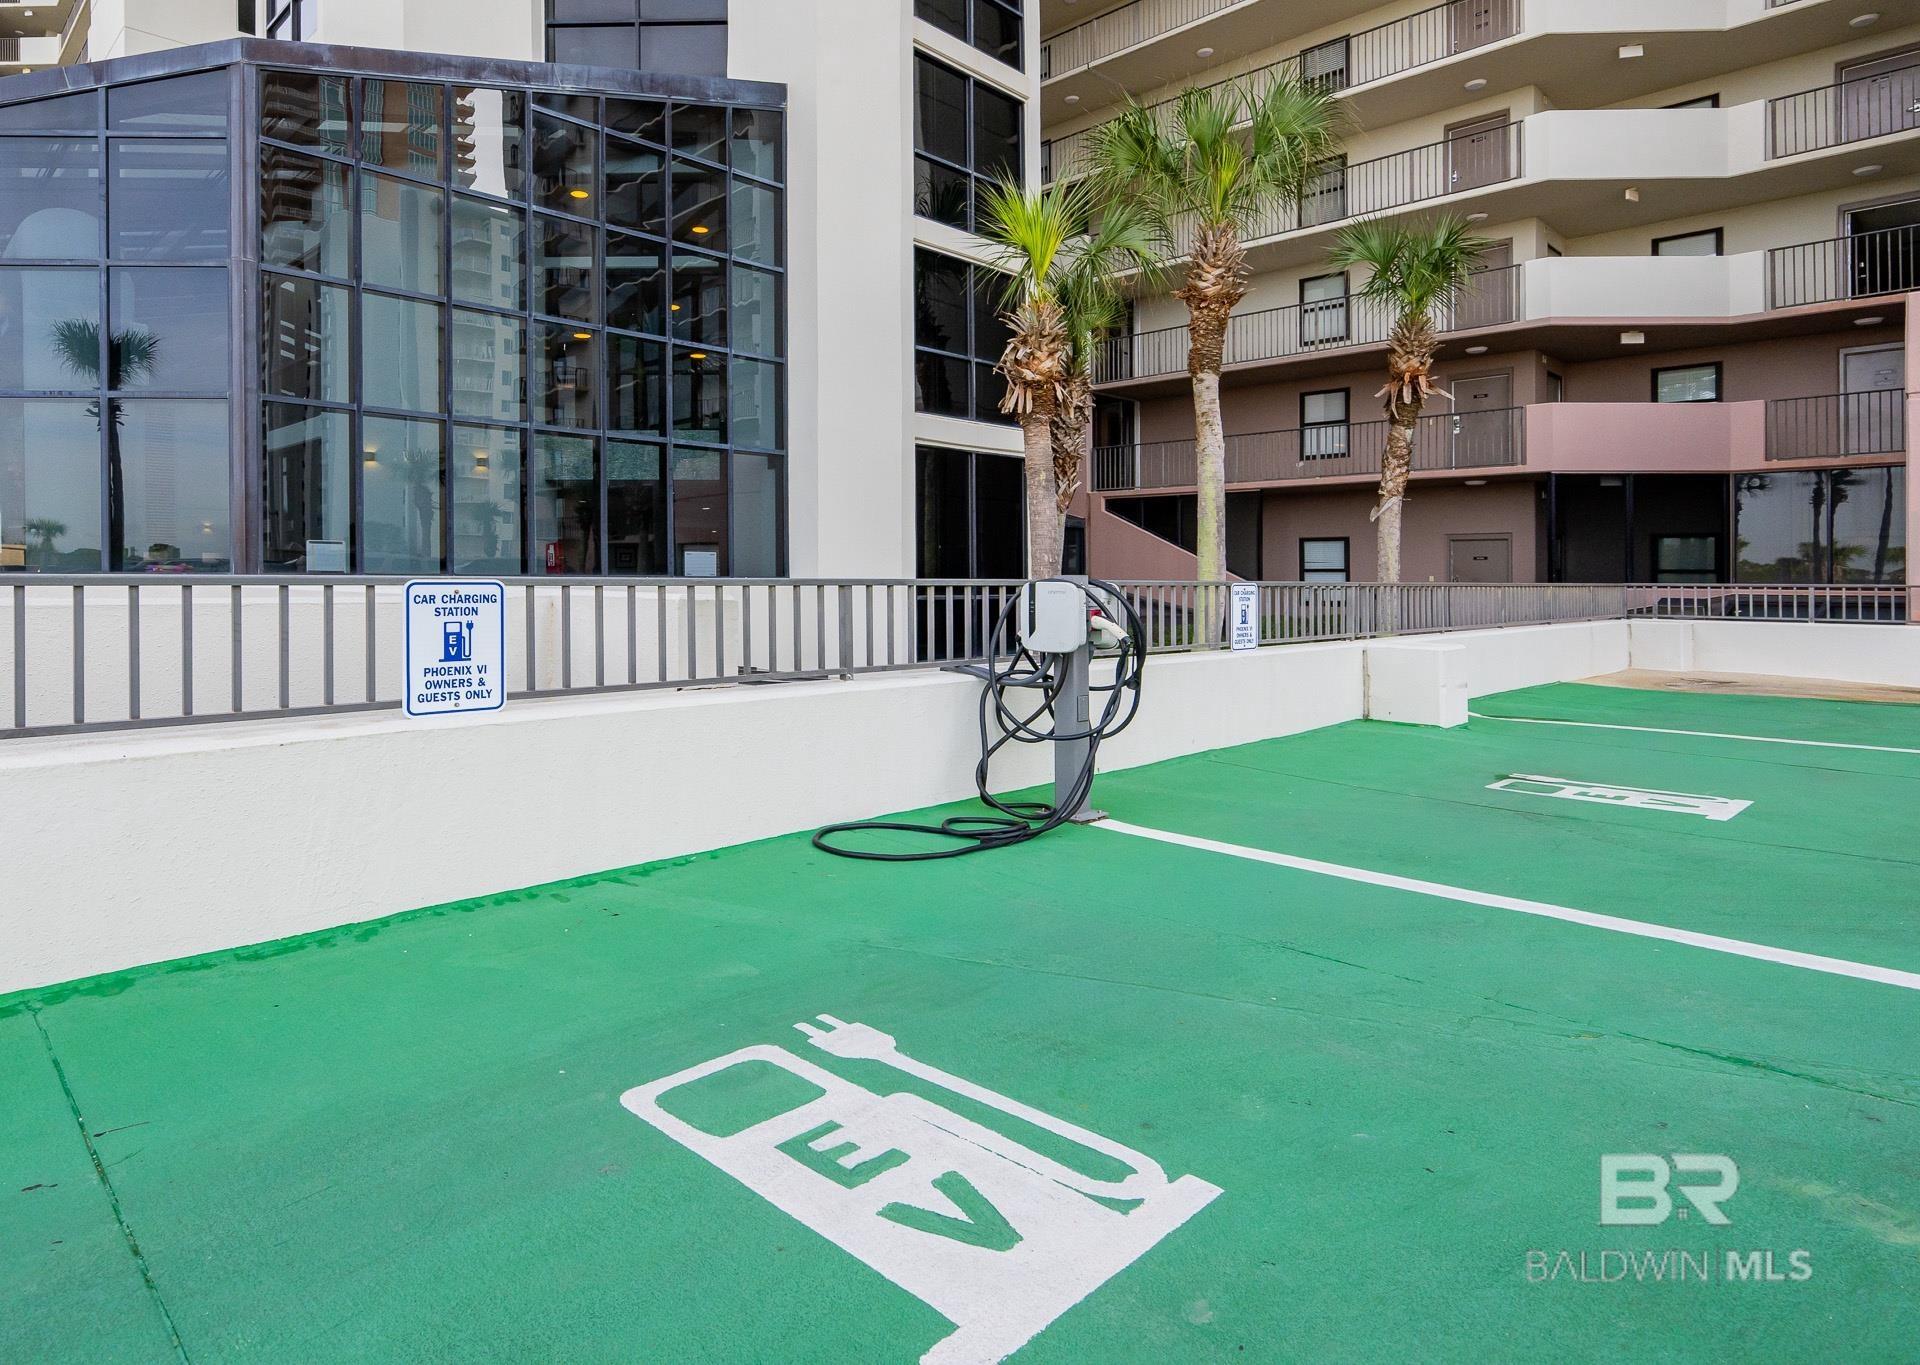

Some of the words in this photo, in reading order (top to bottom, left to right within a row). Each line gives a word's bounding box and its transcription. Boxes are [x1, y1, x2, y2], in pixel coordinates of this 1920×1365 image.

[414, 594, 436, 604] CAR
[441, 594, 498, 604] CHARGING
[434, 606, 479, 617] STATION
[423, 665, 472, 677] PHOENIX
[477, 664, 487, 674] VI
[424, 678, 473, 690] OWNERS
[477, 677, 486, 687] &
[417, 691, 461, 703] GUESTS
[465, 689, 493, 700] ONLY
